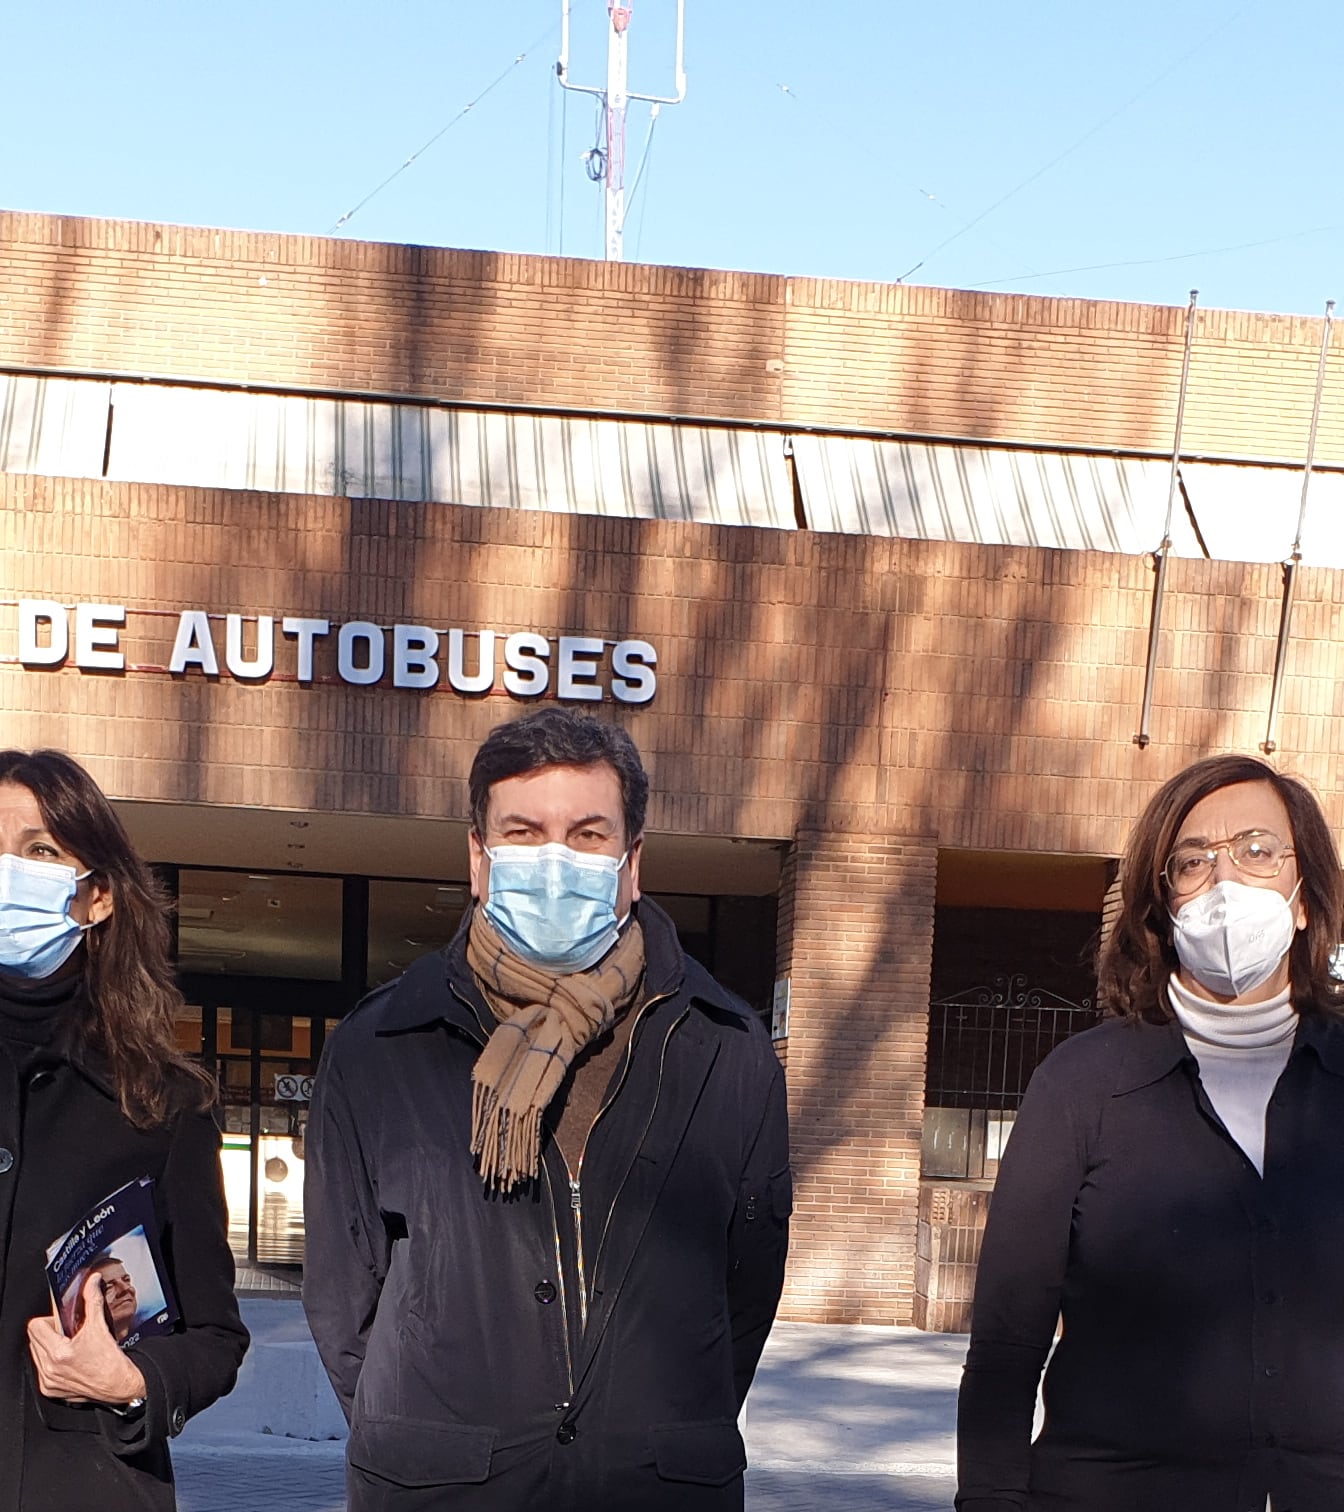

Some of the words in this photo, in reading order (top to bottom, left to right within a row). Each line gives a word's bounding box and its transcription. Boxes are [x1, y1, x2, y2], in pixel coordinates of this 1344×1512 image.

[18, 599, 126, 672] DE
[169, 610, 657, 704] AUTOBUSES
[53, 1234, 80, 1273] Castilla
[79, 1225, 86, 1239] y
[86, 1204, 116, 1230] León
